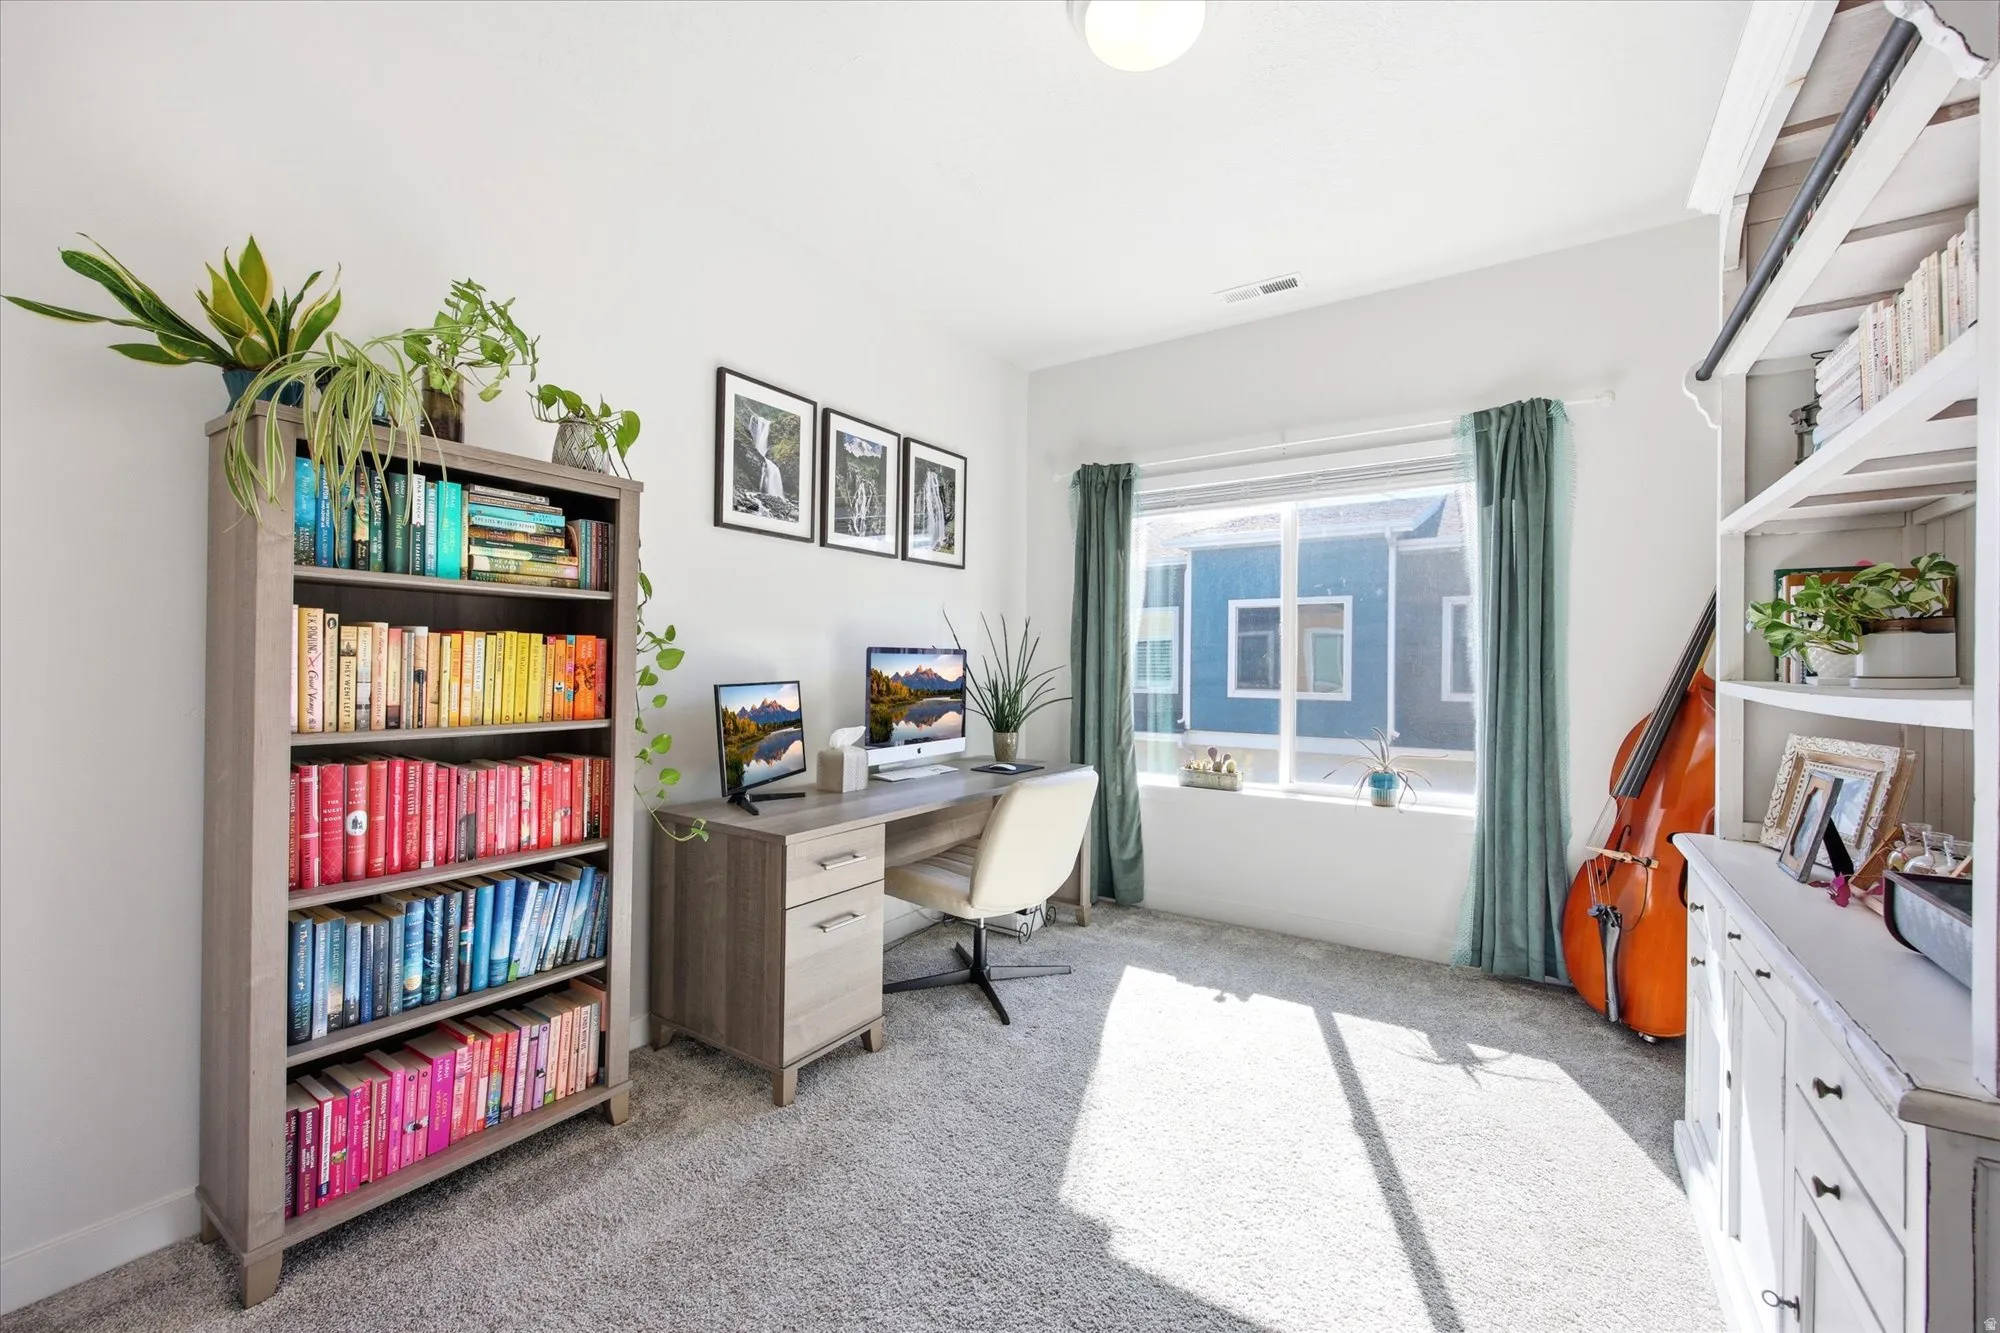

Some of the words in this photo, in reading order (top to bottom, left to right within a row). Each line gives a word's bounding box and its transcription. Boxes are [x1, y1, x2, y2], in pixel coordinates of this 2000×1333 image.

[374, 476, 382, 494] LISA
[374, 495, 382, 525] JEWELL
[307, 626, 317, 654] ROWLING
[308, 670, 319, 690] Casual
[344, 660, 352, 678] THEY
[307, 692, 318, 716] Vacancy
[300, 930, 308, 942] The
[297, 944, 308, 979] Nightingale
[285, 1140, 293, 1166] CROWN
